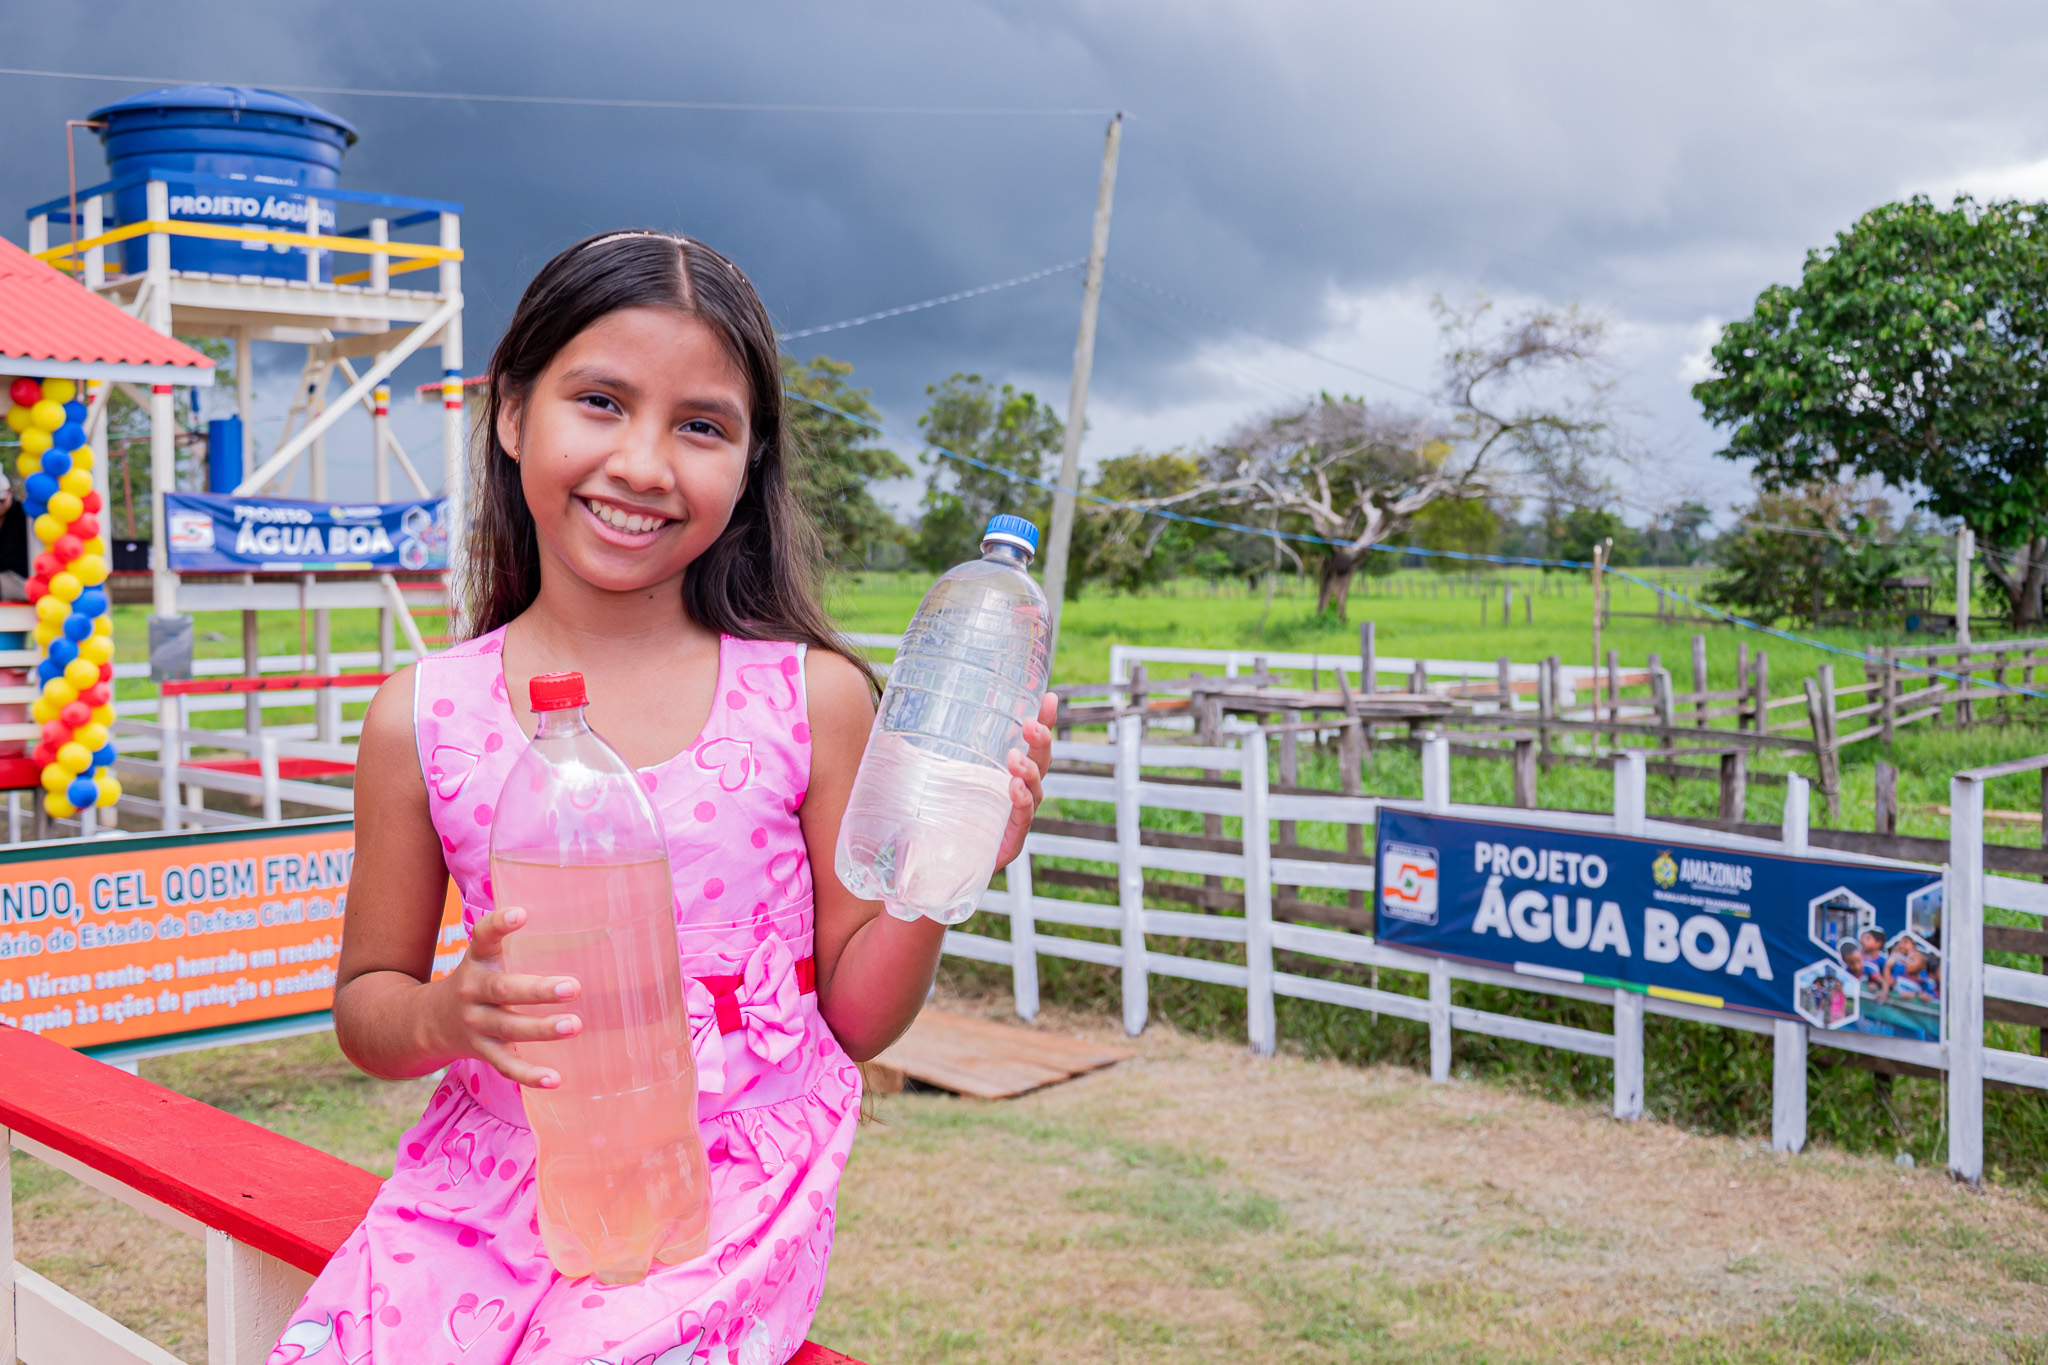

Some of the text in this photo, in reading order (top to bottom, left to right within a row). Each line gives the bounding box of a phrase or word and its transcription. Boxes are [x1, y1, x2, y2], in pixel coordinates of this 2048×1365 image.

[170, 195, 260, 217] PROJETO
[234, 505, 313, 524] PROJETO
[235, 520, 394, 555] ÁGUA BOA
[92, 872, 156, 911] CEL
[164, 860, 256, 904] QOBM
[1475, 841, 1608, 888] PROJETO
[1679, 857, 1752, 891] AMAZONAS
[47, 929, 76, 952] de
[79, 918, 154, 948] Estado
[157, 914, 185, 938] de
[187, 908, 257, 935] Defesa
[261, 899, 304, 925] Civil
[307, 897, 333, 920] do
[1471, 875, 1774, 981] ÁGUA BOA
[26, 972, 91, 999] Várzea
[94, 964, 174, 990] sente-se
[175, 948, 247, 979] honrado
[250, 949, 276, 969] em
[21, 1004, 72, 1034] apoio
[76, 999, 99, 1025] às
[102, 993, 155, 1025] ações
[157, 989, 180, 1013] de
[182, 977, 257, 1014] proteção
[259, 979, 271, 998] e
